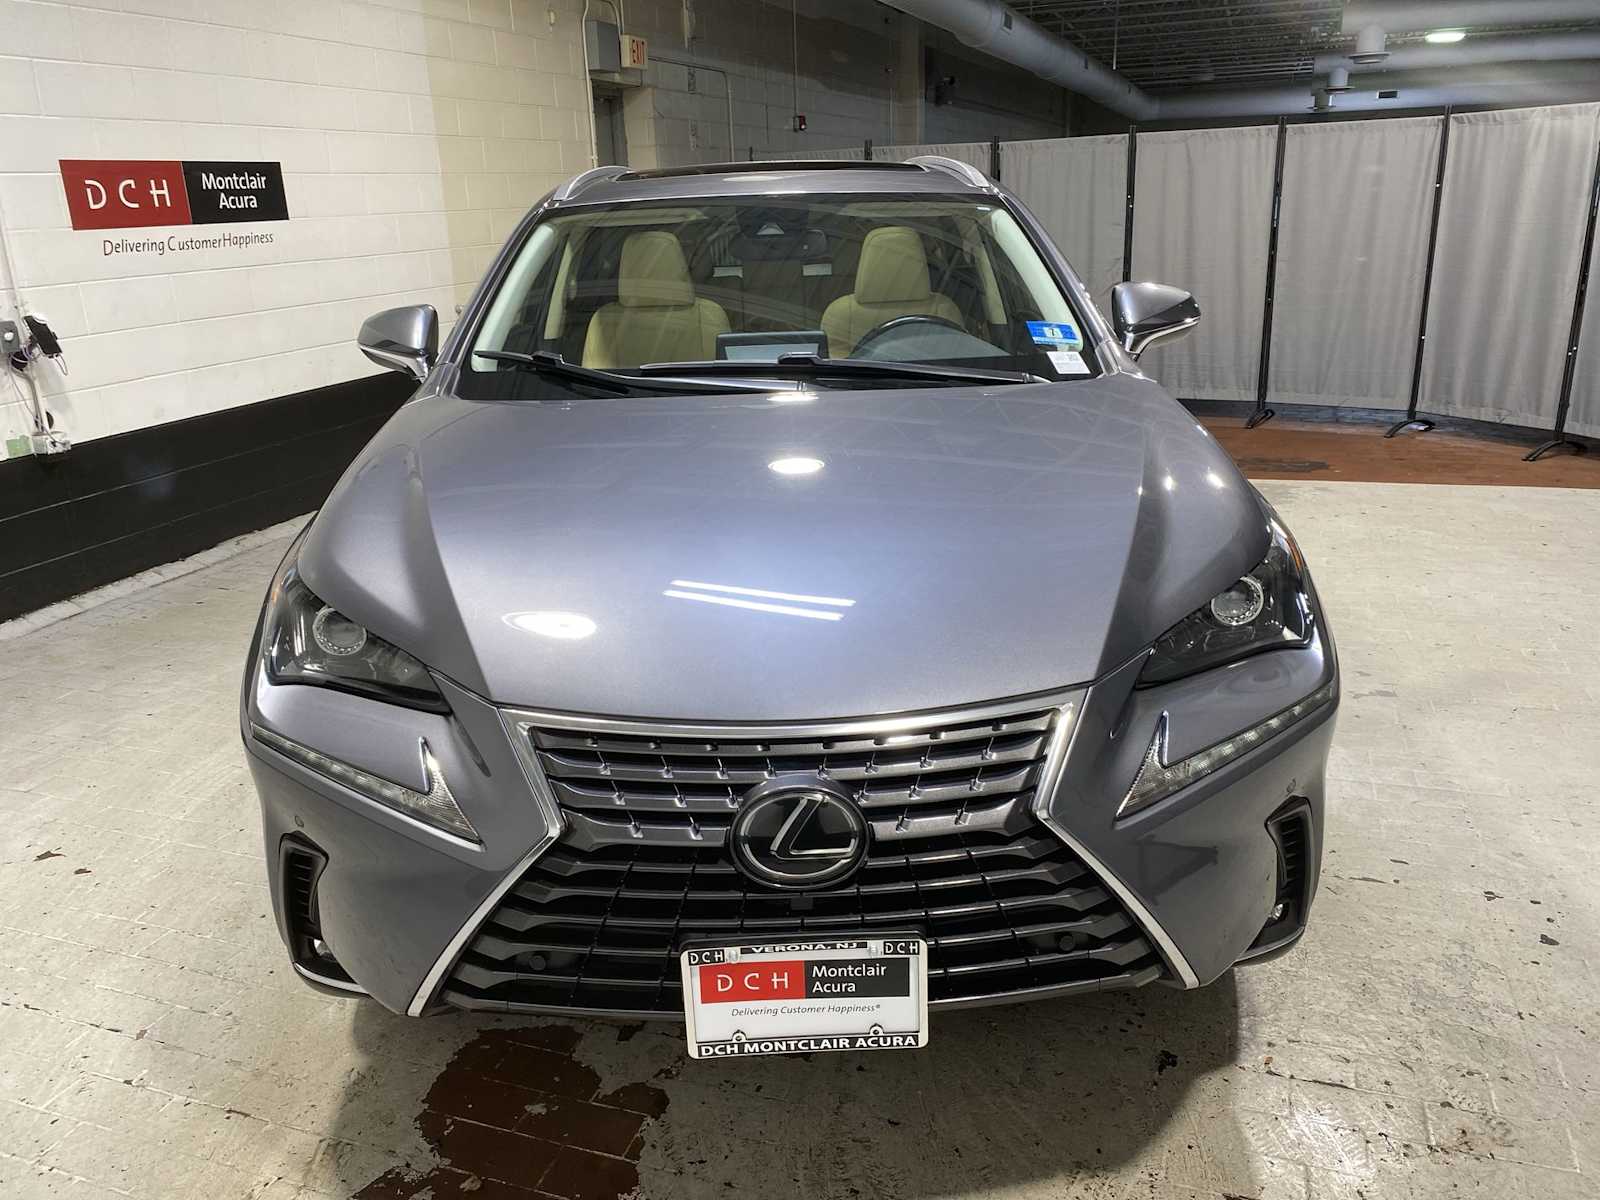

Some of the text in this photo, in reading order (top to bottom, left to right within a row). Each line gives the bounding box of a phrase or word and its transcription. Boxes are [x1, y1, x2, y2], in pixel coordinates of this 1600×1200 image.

[632, 39, 645, 65] EXIT
[202, 172, 266, 190] Montclair
[84, 179, 172, 210] DCH
[219, 193, 258, 210] Acura
[103, 232, 274, 256] Delivering Customer Happiness
[884, 942, 919, 954] DCH
[689, 950, 724, 964] DCH
[812, 964, 887, 978] Montclair
[716, 972, 788, 992] DCH
[812, 979, 856, 994] Acura
[731, 1006, 779, 1017] Delivering
[780, 1003, 826, 1015] Customer
[701, 1035, 917, 1056] DCH MONTCLAIR ACURA
